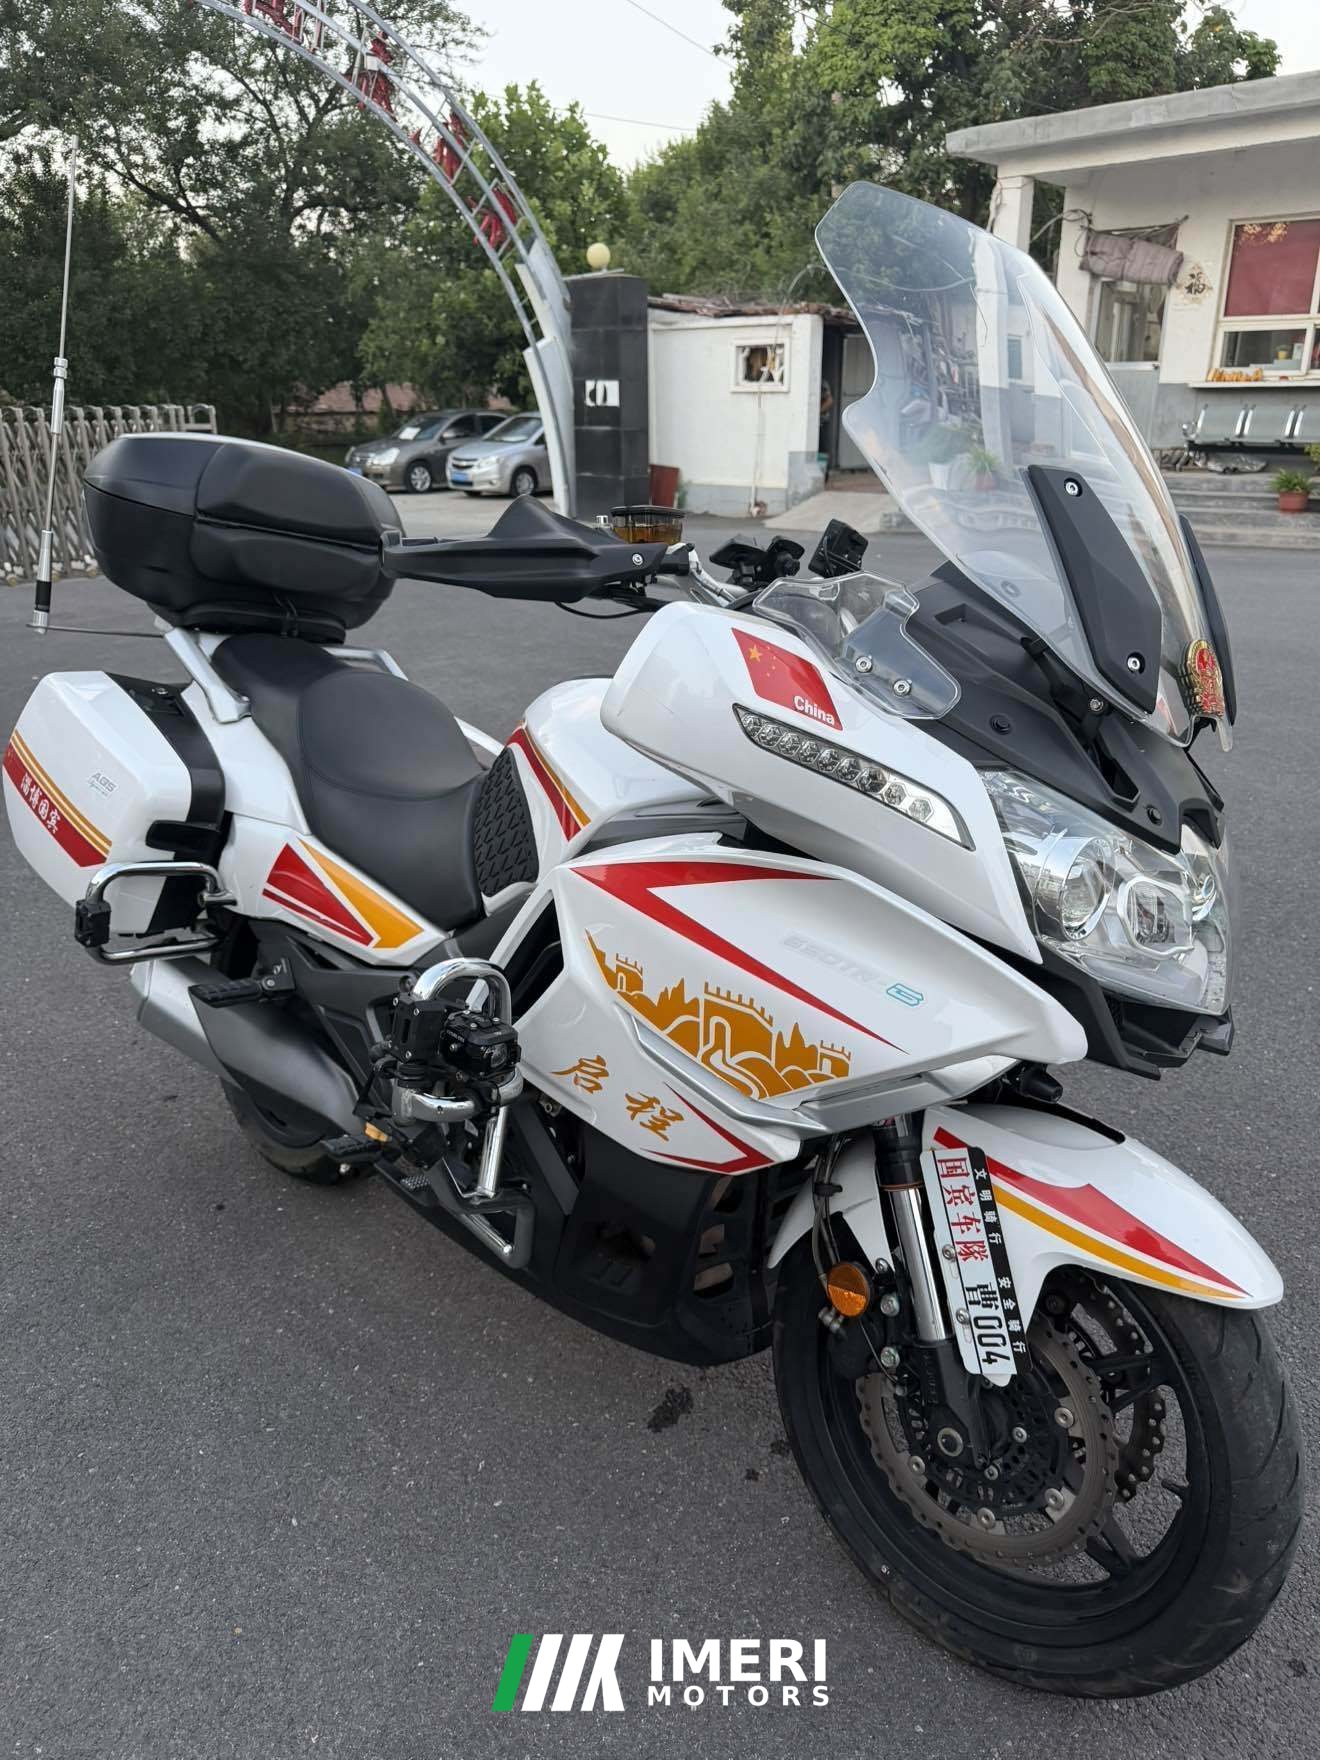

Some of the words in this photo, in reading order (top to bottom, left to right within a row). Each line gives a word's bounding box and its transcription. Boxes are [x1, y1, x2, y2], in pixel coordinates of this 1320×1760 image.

[794, 695, 835, 726] China
[549, 1054, 685, 1142] 启程
[974, 1168, 1002, 1245] 文明骑行
[998, 1276, 1027, 1353] 安全骑行
